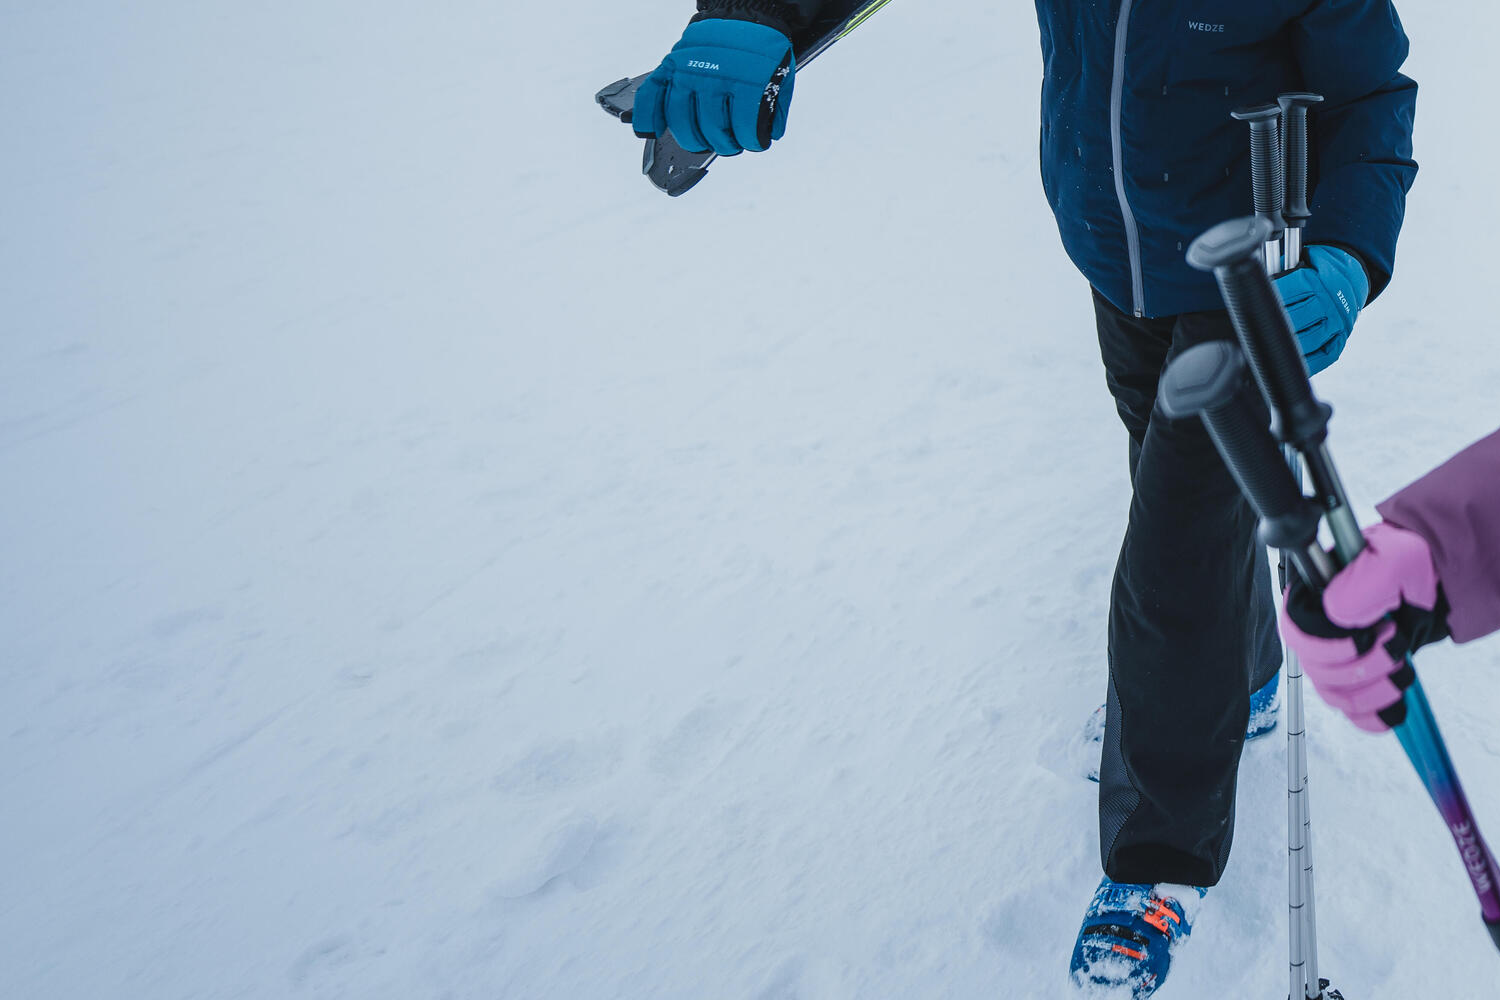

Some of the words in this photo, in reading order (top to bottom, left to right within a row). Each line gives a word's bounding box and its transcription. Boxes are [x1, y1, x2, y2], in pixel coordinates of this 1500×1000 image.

[1188, 20, 1225, 33] WEDZE
[687, 60, 720, 71] WEDZE
[1336, 289, 1350, 314] WEDZE
